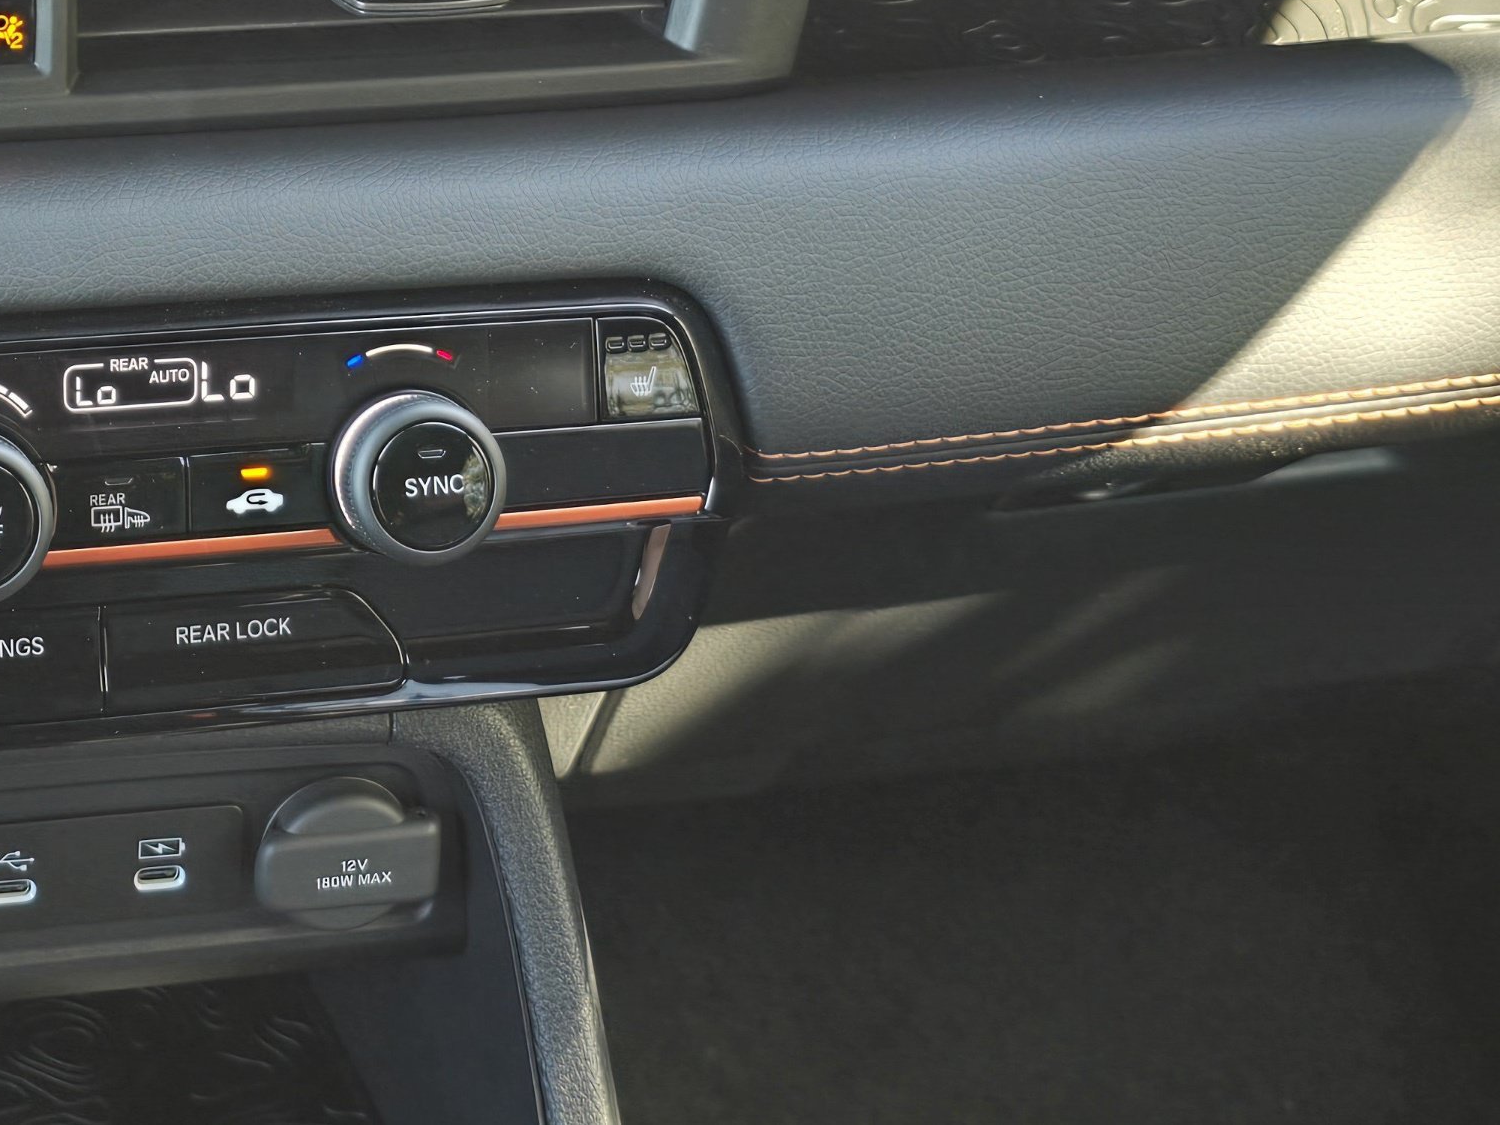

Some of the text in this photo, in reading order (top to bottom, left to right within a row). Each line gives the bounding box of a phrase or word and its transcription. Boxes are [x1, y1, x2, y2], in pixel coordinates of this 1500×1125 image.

[109, 356, 149, 372] REAR
[149, 368, 190, 384] AUTO
[201, 361, 256, 402] Lo
[404, 474, 465, 498] SYNC
[89, 492, 126, 507] REAR
[174, 618, 292, 646] REAR LOCK
[341, 858, 369, 872] 12V
[316, 871, 392, 890] 180W MAX
